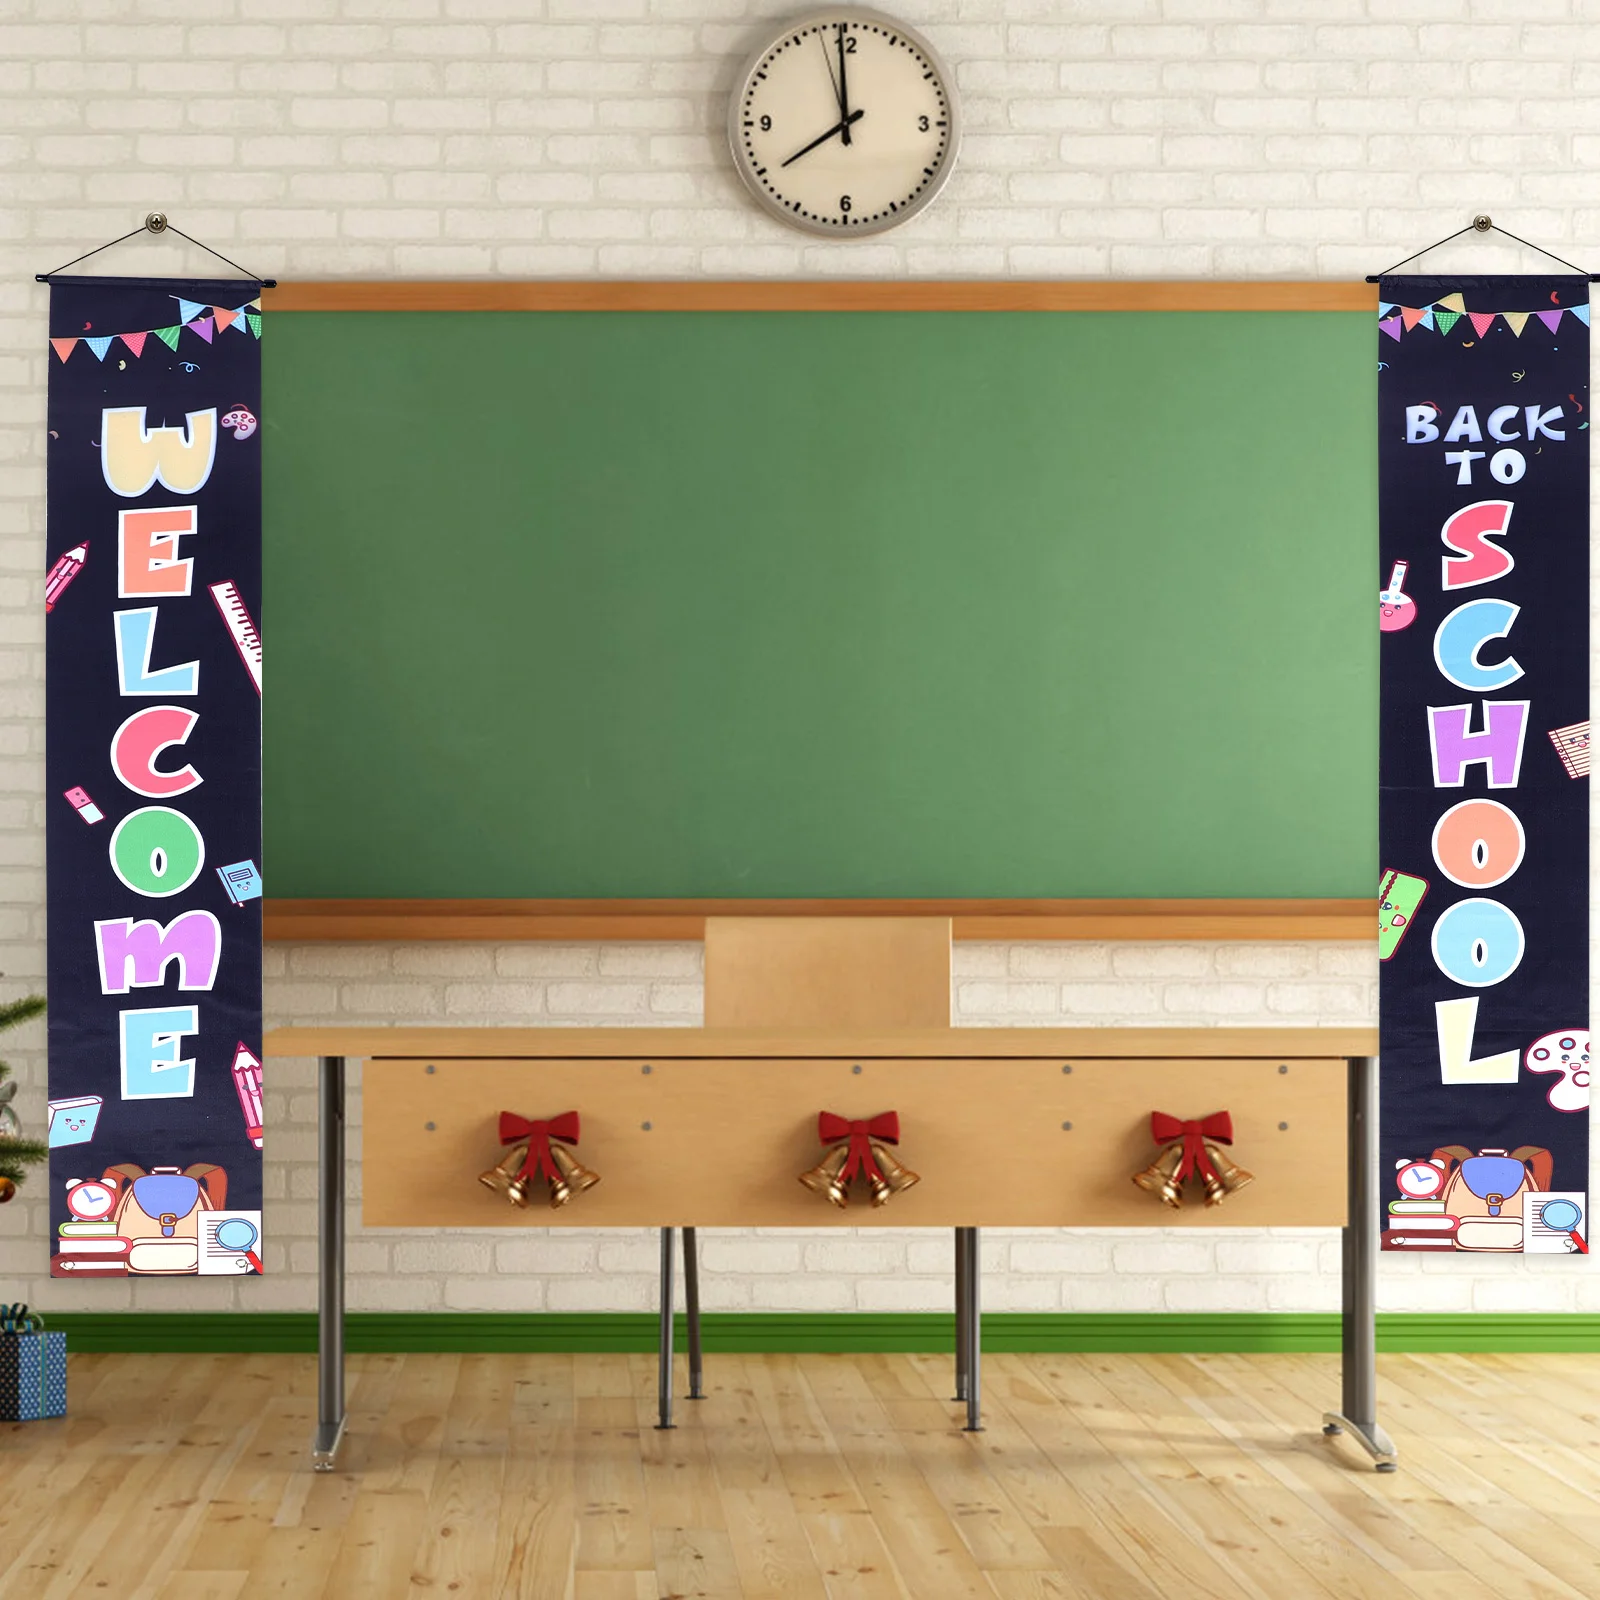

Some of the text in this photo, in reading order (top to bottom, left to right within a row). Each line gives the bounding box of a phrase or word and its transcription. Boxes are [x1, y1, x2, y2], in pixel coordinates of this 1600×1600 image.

[760, 115, 772, 132] 9
[917, 115, 930, 132] 3
[839, 195, 852, 212] 6
[1405, 404, 1566, 444] BACK
[1445, 448, 1527, 485] TO
[1427, 499, 1531, 1085] SCHOOL
